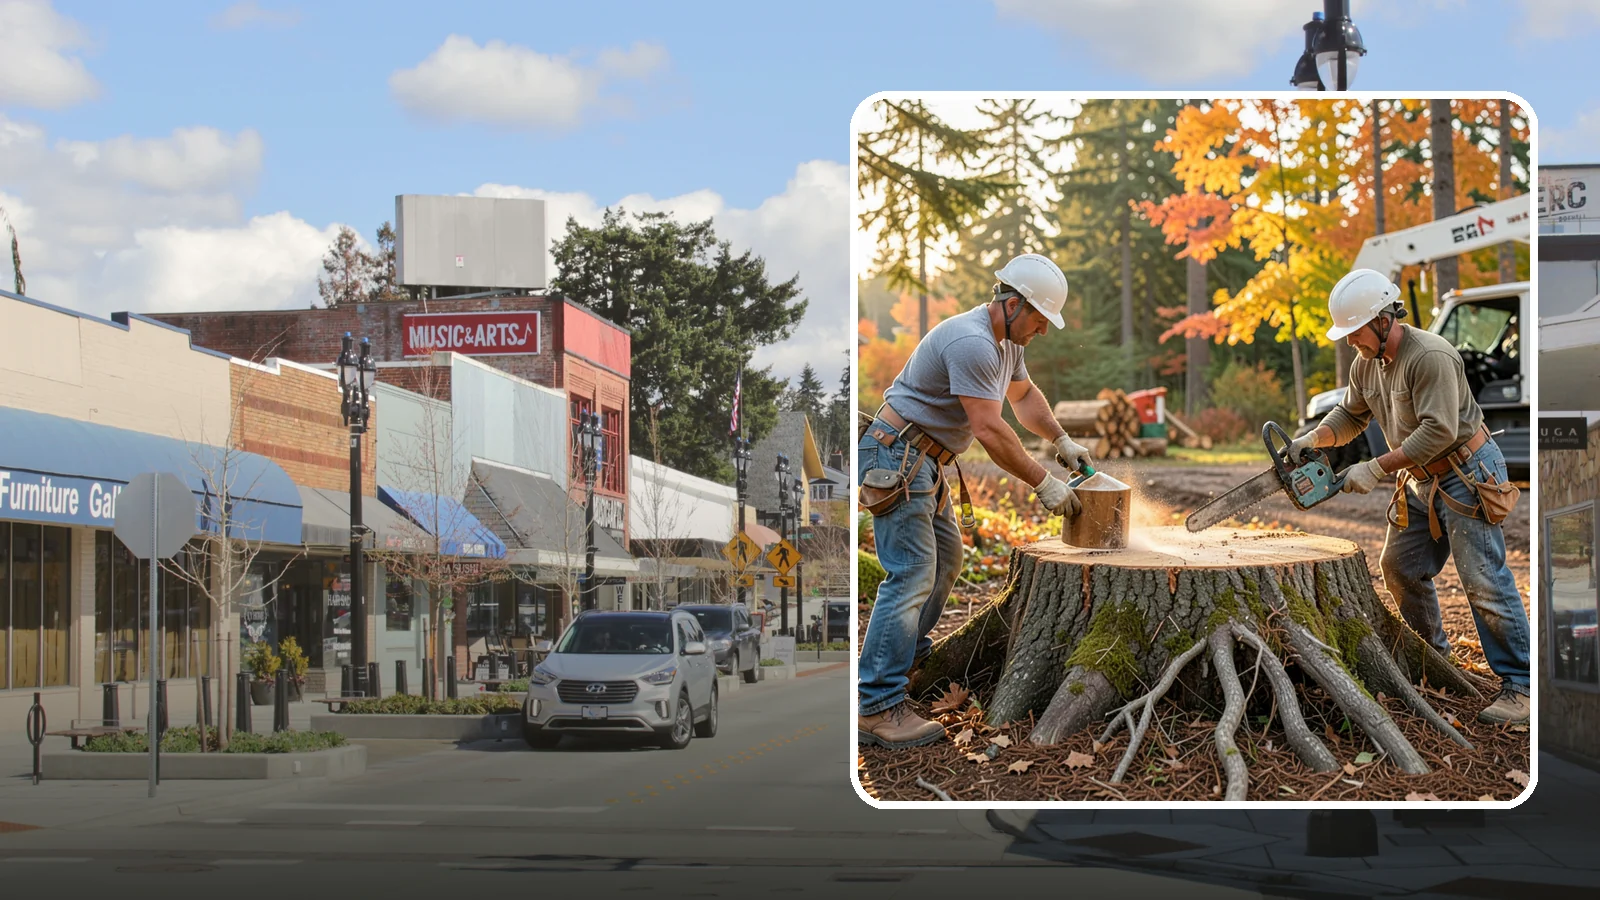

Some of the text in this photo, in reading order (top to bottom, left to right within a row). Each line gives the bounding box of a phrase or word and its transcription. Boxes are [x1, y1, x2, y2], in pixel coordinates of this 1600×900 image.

[409, 323, 519, 349] MUSIC&ARTS
[0, 471, 79, 515] Furniture
[453, 563, 479, 575] SUSHI
